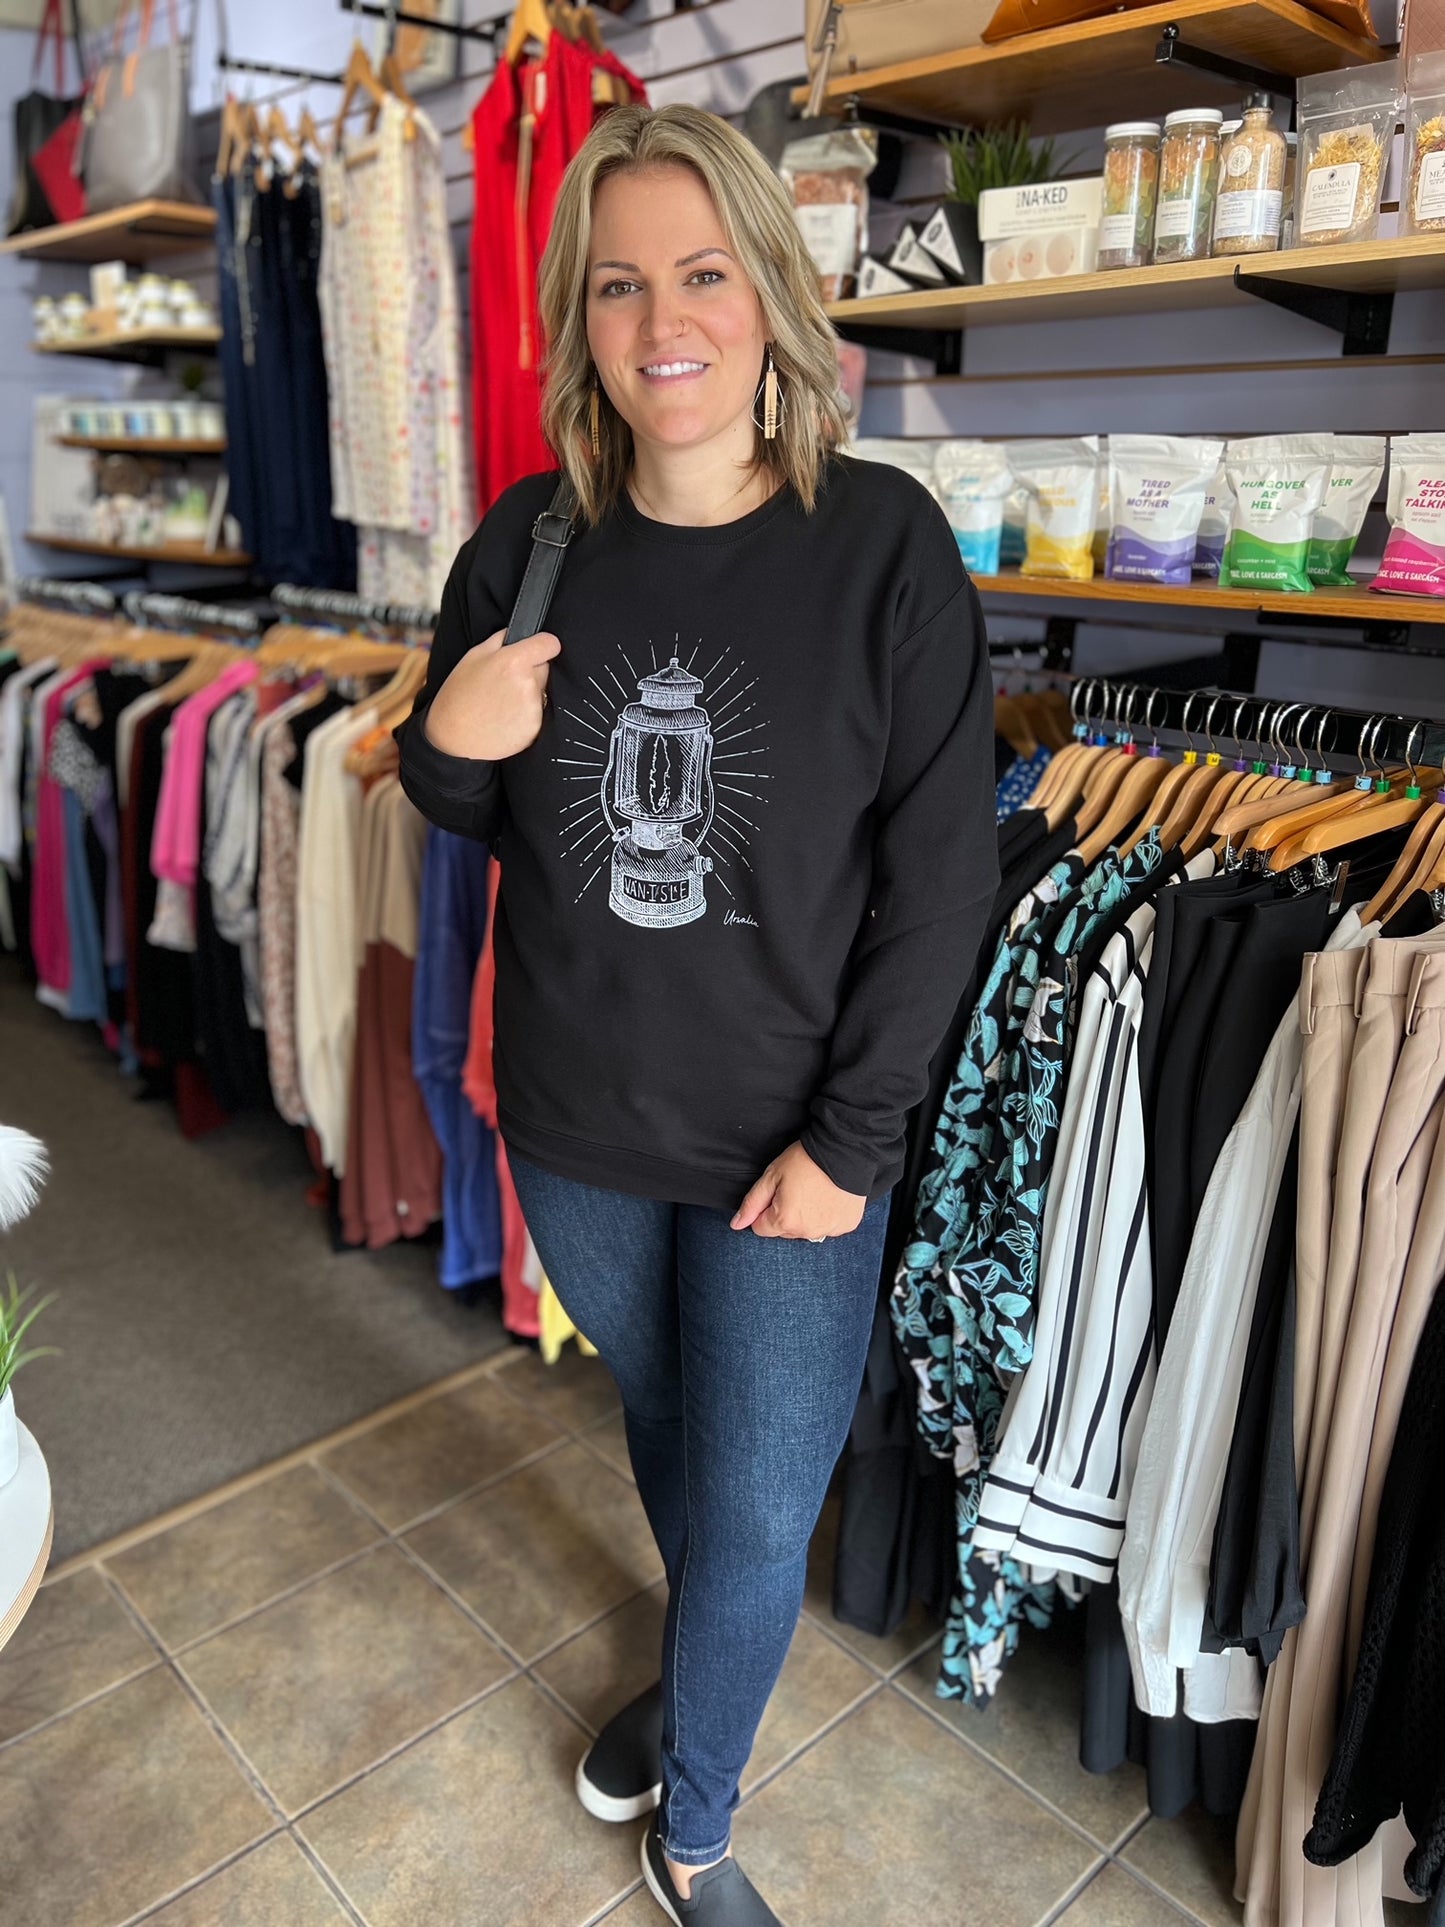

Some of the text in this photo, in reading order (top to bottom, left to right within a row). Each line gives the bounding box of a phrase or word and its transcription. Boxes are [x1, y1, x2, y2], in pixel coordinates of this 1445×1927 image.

[1141, 479, 1171, 489] TIRED
[1240, 480, 1306, 490] HUNGOVER
[1418, 479, 1445, 488] PLEA
[1261, 490, 1279, 499] AS
[1419, 489, 1445, 498] STO
[1126, 498, 1170, 508] MOTHER
[1251, 501, 1282, 510] HELL
[1405, 498, 1445, 509] TALKIN
[1390, 570, 1405, 579] LOVE
